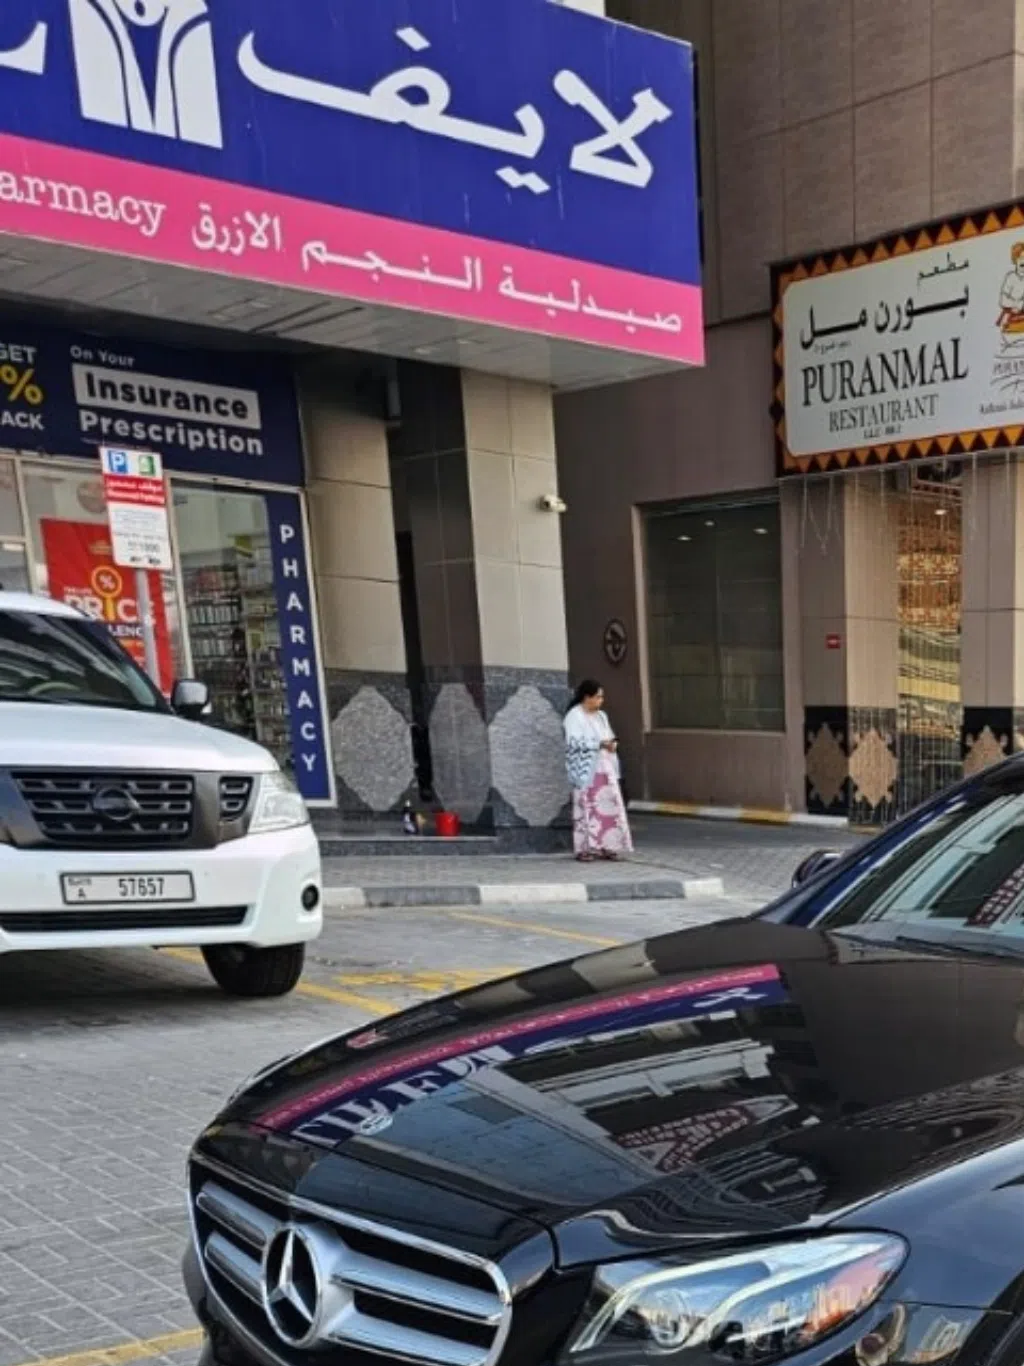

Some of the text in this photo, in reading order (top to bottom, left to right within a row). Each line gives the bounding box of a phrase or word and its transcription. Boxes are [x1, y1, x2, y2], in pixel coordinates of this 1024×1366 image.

[236, 26, 673, 194] لايف
[301, 239, 482, 293] النجم
[916, 252, 970, 288] مطعم
[499, 265, 682, 334] صيدلية
[800, 284, 970, 351] بورن مل
[70, 345, 135, 368] On Your
[801, 337, 969, 407] PURANMAL
[86, 371, 249, 420] Insurance
[828, 393, 939, 433] RESTAURANT
[79, 409, 263, 456] Prescription
[280, 524, 317, 772] PHARMACY
[118, 876, 165, 897] 57657
